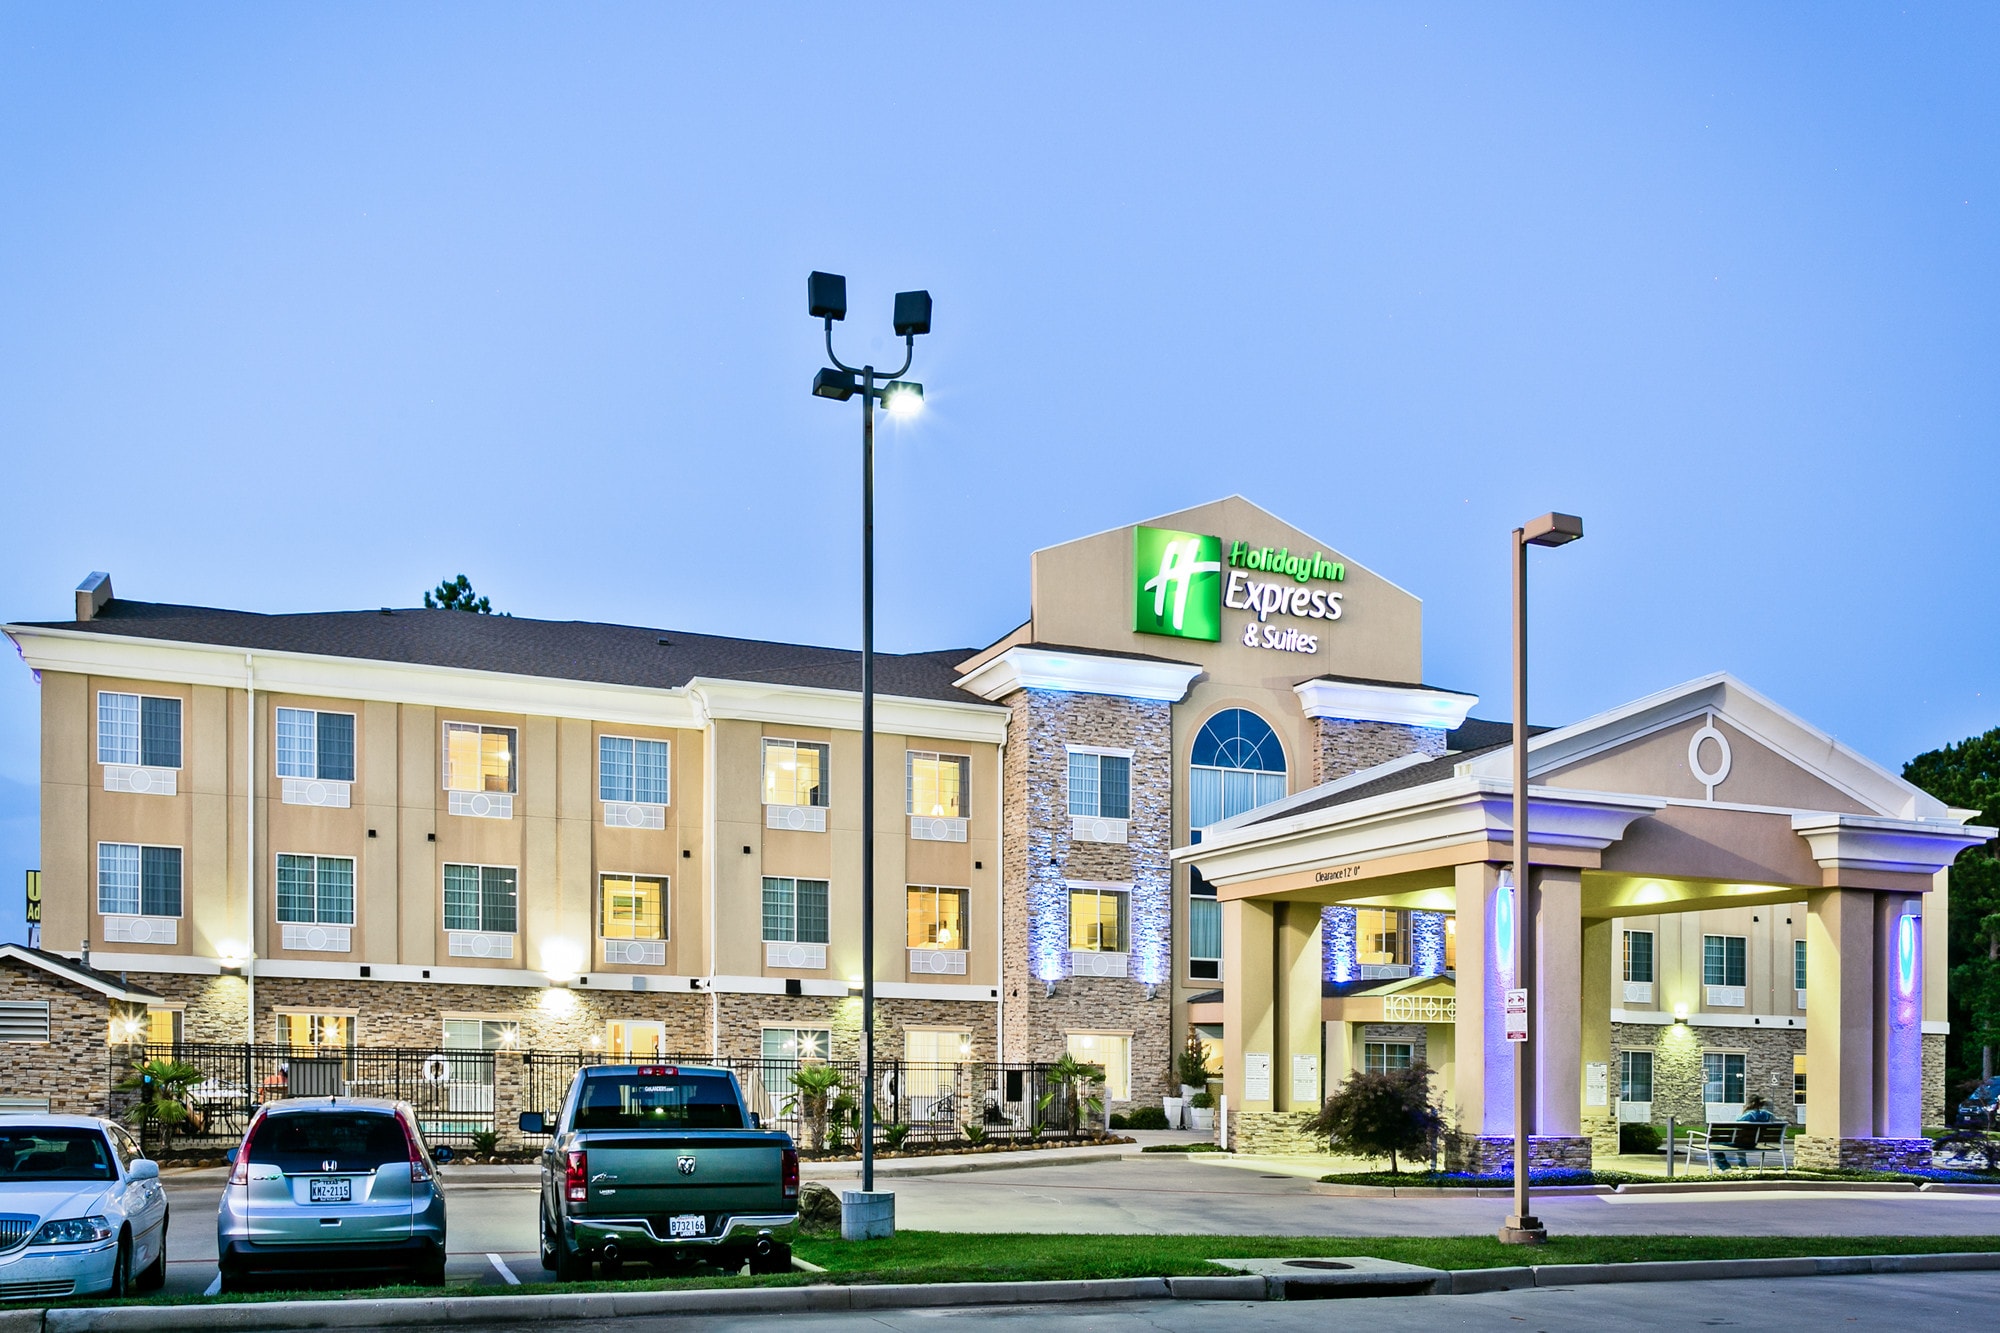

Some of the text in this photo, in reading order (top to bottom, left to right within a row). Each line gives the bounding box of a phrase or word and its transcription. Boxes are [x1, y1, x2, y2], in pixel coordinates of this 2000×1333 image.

[1228, 540, 1346, 583] Holiday Inn
[1224, 570, 1344, 623] Express
[1243, 622, 1319, 655] & Suites
[1315, 870, 1343, 883] Clearance
[671, 1220, 705, 1231] B732166
